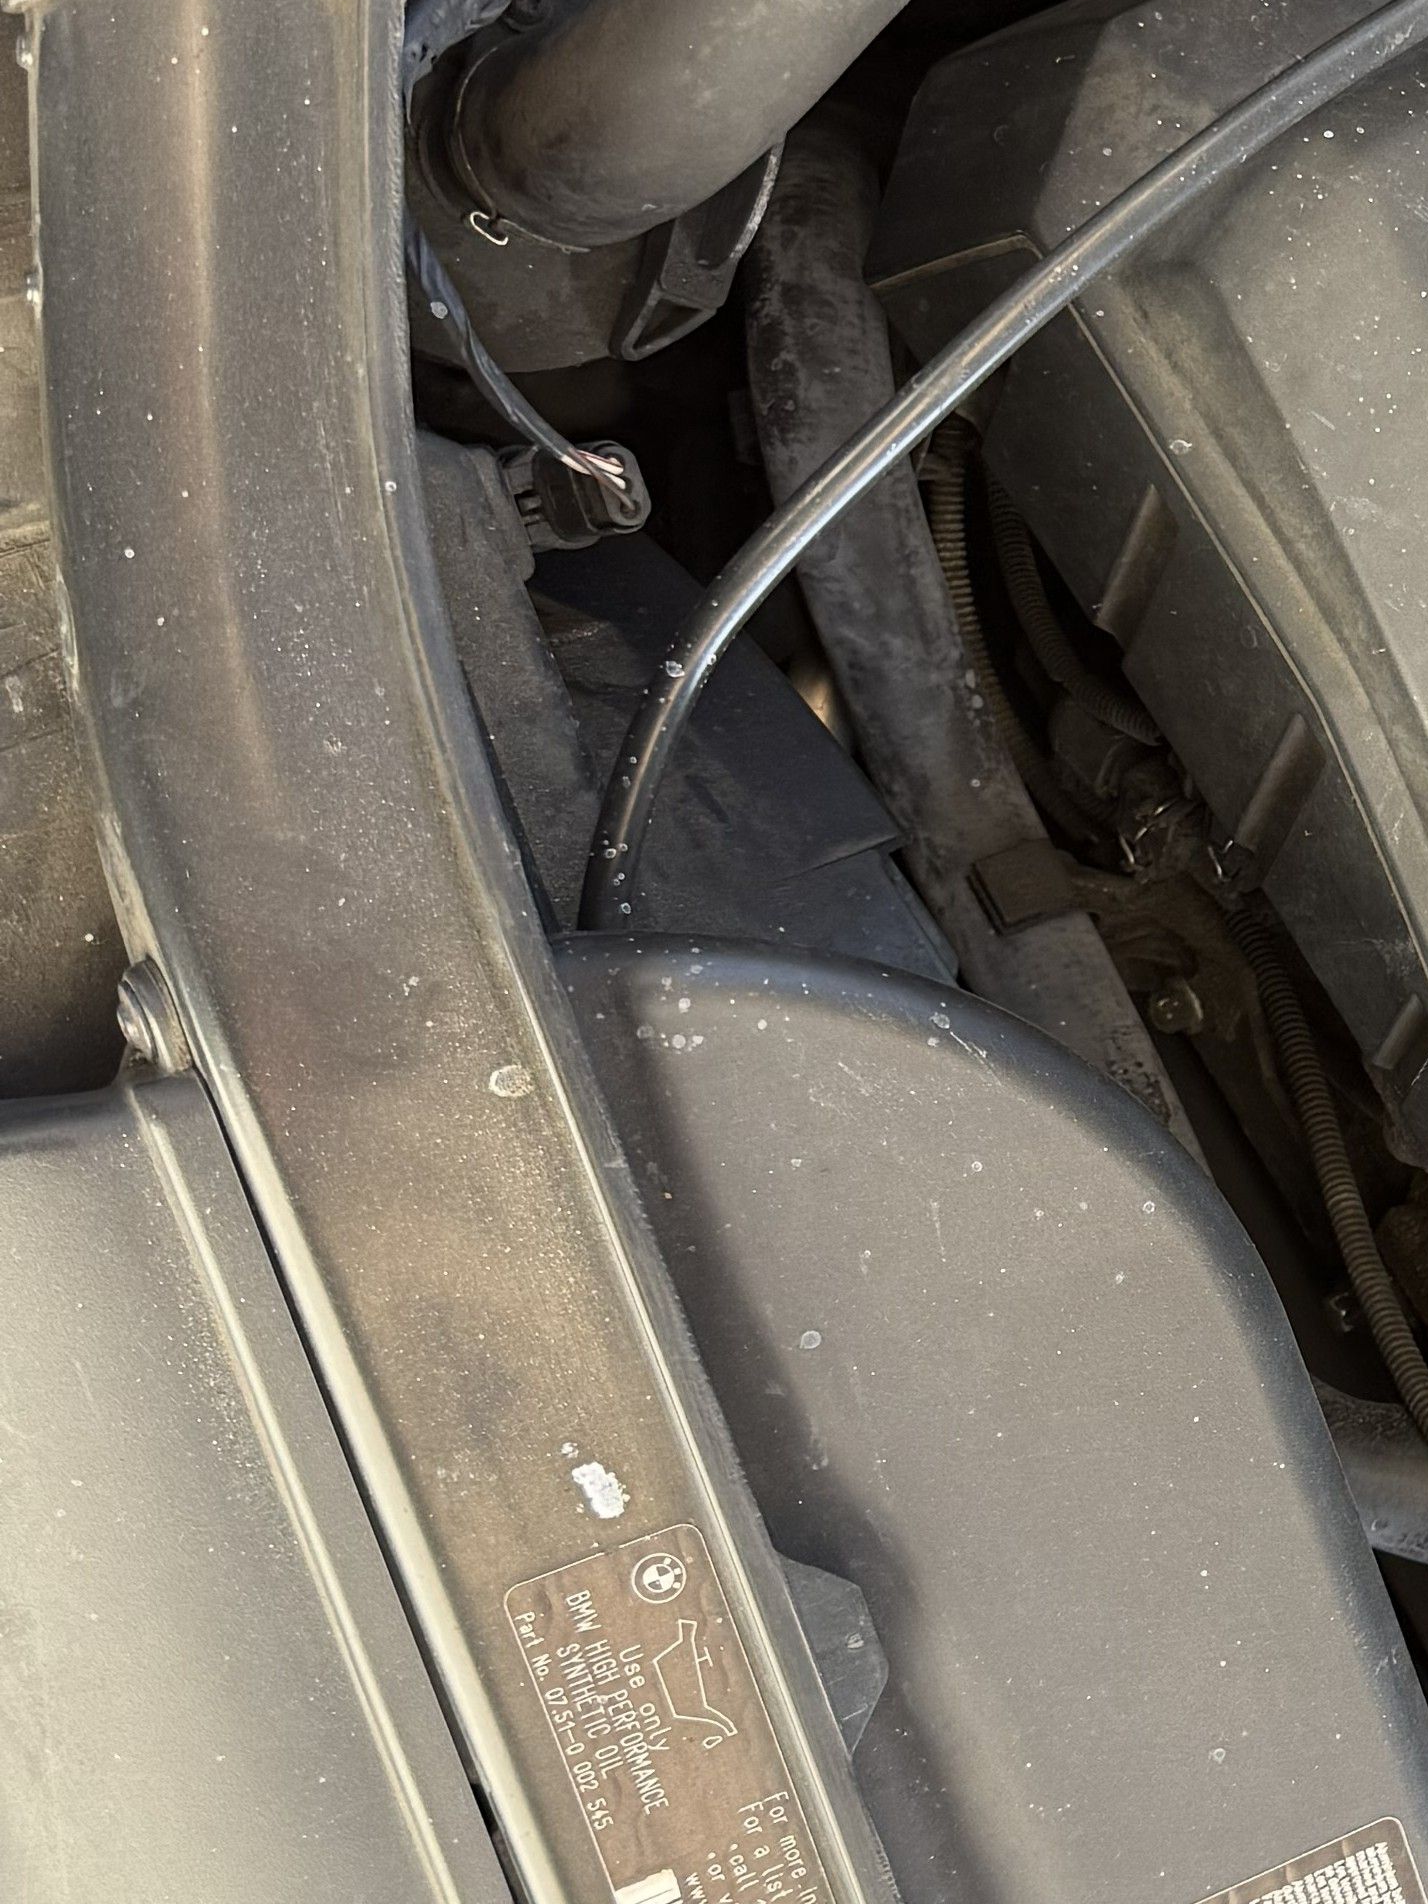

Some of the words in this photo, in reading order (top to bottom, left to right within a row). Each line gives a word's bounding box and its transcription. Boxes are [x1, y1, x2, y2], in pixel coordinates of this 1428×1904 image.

[514, 1610, 544, 1648] Part
[565, 1589, 601, 1633] BMW
[530, 1652, 552, 1681] No.
[584, 1638, 620, 1685] HIGH
[556, 1642, 611, 1738] SYNTHETIC
[593, 1744, 624, 1779] OIL
[618, 1643, 645, 1689] Use
[633, 1702, 672, 1750] only
[601, 1688, 668, 1814] PERFORMANCE
[572, 1760, 599, 1793] 002
[585, 1797, 614, 1830] 545
[737, 1800, 764, 1834] For
[752, 1844, 770, 1859] a
[762, 1790, 789, 1824] For
[778, 1834, 807, 1879] more
[706, 1863, 725, 1881] or
[728, 1854, 759, 1891] call
[760, 1862, 793, 1902] list
